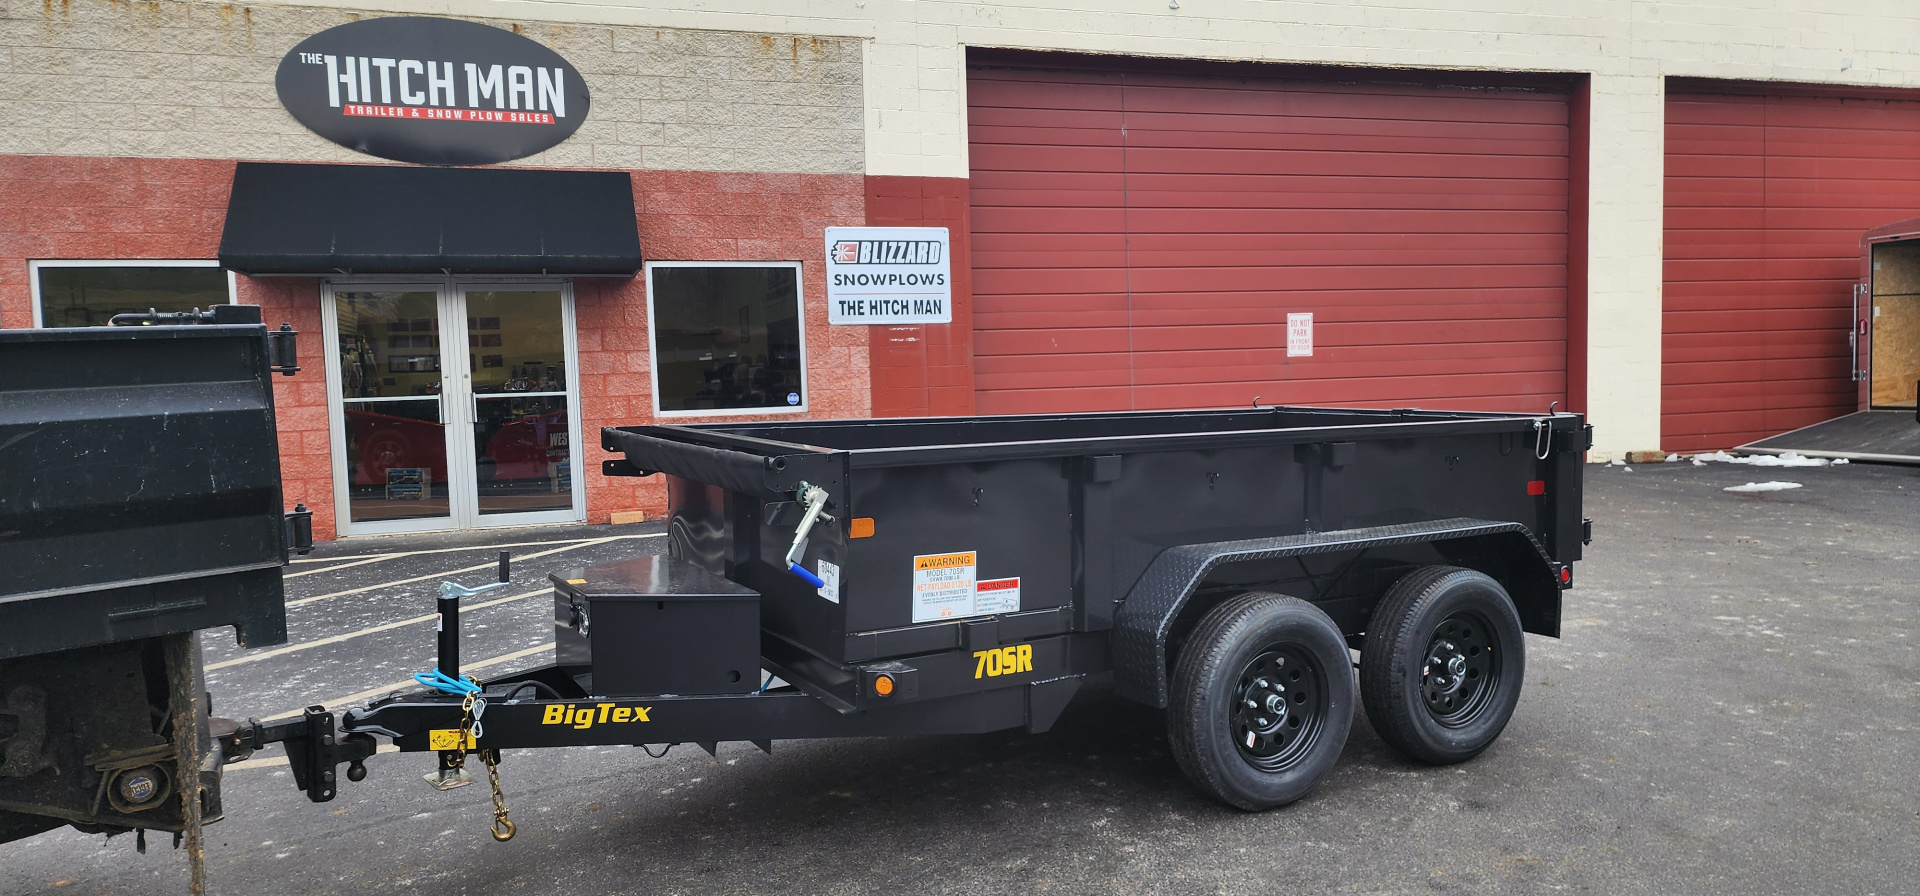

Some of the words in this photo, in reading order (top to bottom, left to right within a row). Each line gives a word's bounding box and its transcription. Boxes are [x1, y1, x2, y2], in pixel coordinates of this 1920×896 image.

[299, 52, 323, 65] THE
[324, 54, 455, 108] HITCH
[464, 63, 566, 118] MAN
[349, 105, 404, 117] TRAILER
[411, 108, 420, 118] &
[427, 109, 463, 119] SNOW
[470, 111, 503, 121] PLOW
[510, 113, 549, 123] SALES
[859, 241, 941, 264] BLIZZARD
[834, 273, 945, 286] SNOWPLOWS
[838, 300, 865, 316] THE
[869, 300, 909, 316] HITCH
[914, 300, 942, 315] MAN
[1290, 319, 1298, 327] DO
[1300, 319, 1309, 327] NOT
[549, 432, 568, 446] WES
[928, 556, 970, 567] WARNING
[926, 569, 947, 577] MODEL
[949, 567, 964, 575] 70SR
[916, 584, 927, 592] NET
[927, 581, 951, 591] PAYLOAD
[951, 580, 964, 589] 5120
[987, 581, 1013, 589] DANGER
[973, 644, 1033, 680] 70SR
[541, 702, 653, 730] BigTex
